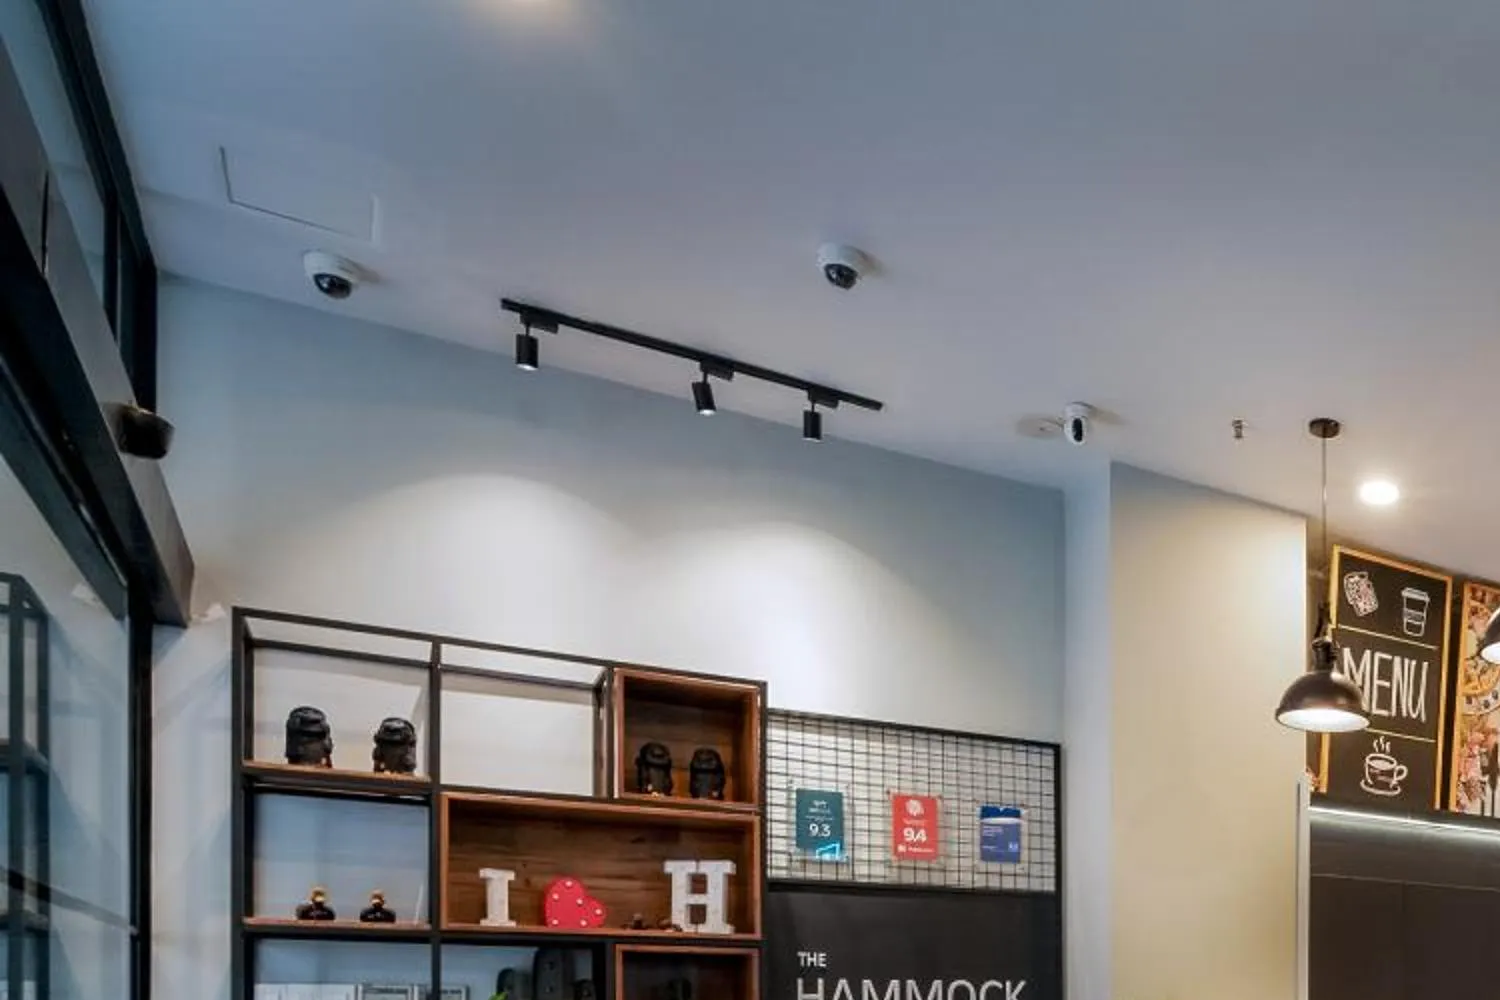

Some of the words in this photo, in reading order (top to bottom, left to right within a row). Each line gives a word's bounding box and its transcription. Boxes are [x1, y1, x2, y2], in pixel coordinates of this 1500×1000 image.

[1342, 647, 1428, 723] MENU
[809, 823, 831, 837] 9.3
[479, 868, 516, 926] I
[664, 860, 736, 934] H
[798, 952, 827, 967] THE
